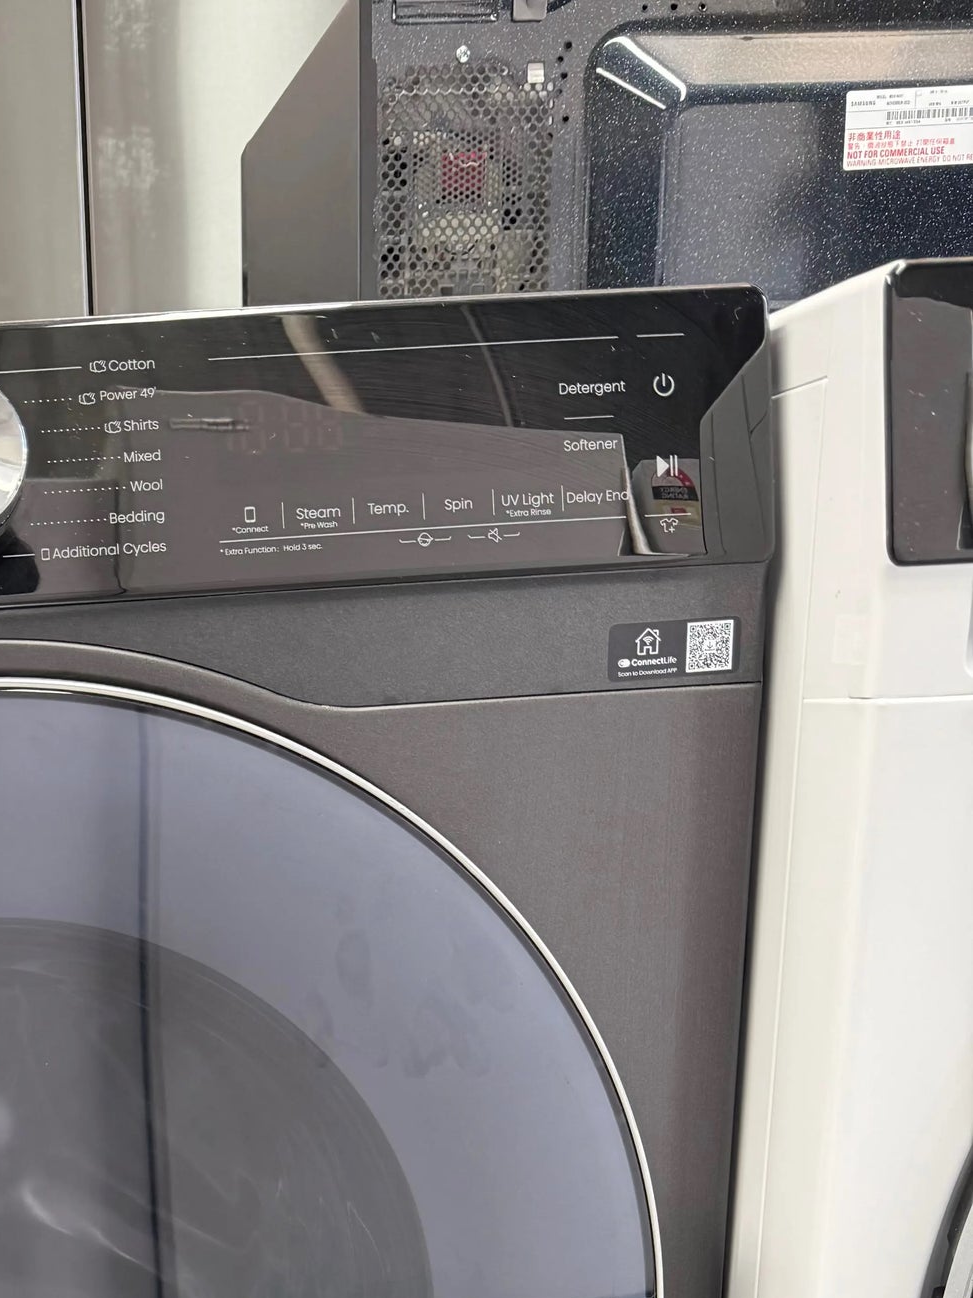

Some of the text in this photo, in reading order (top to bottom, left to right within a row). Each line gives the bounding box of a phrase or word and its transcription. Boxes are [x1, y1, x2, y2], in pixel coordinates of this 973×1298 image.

[847, 146, 944, 159] NOT FOR COMMERCIAL USE
[847, 159, 876, 167] WARNING
[108, 359, 155, 371] Cotton
[100, 389, 137, 401] Power
[559, 381, 625, 396] Detergent
[124, 419, 159, 431] Shirts
[564, 439, 617, 451] Softener
[124, 450, 161, 462] Mixed
[130, 479, 163, 492] Wool
[501, 492, 554, 507] UV Light
[567, 491, 603, 504] Delay
[367, 503, 409, 516] Temp.
[445, 498, 473, 512] Spin
[109, 510, 165, 524] Bedding
[296, 507, 341, 520] Steam
[317, 521, 338, 529] Wash
[53, 541, 167, 559] Additional Cycles
[245, 545, 279, 554] Function:
[283, 543, 301, 551] Hold
[632, 656, 677, 666] ConnectLife
